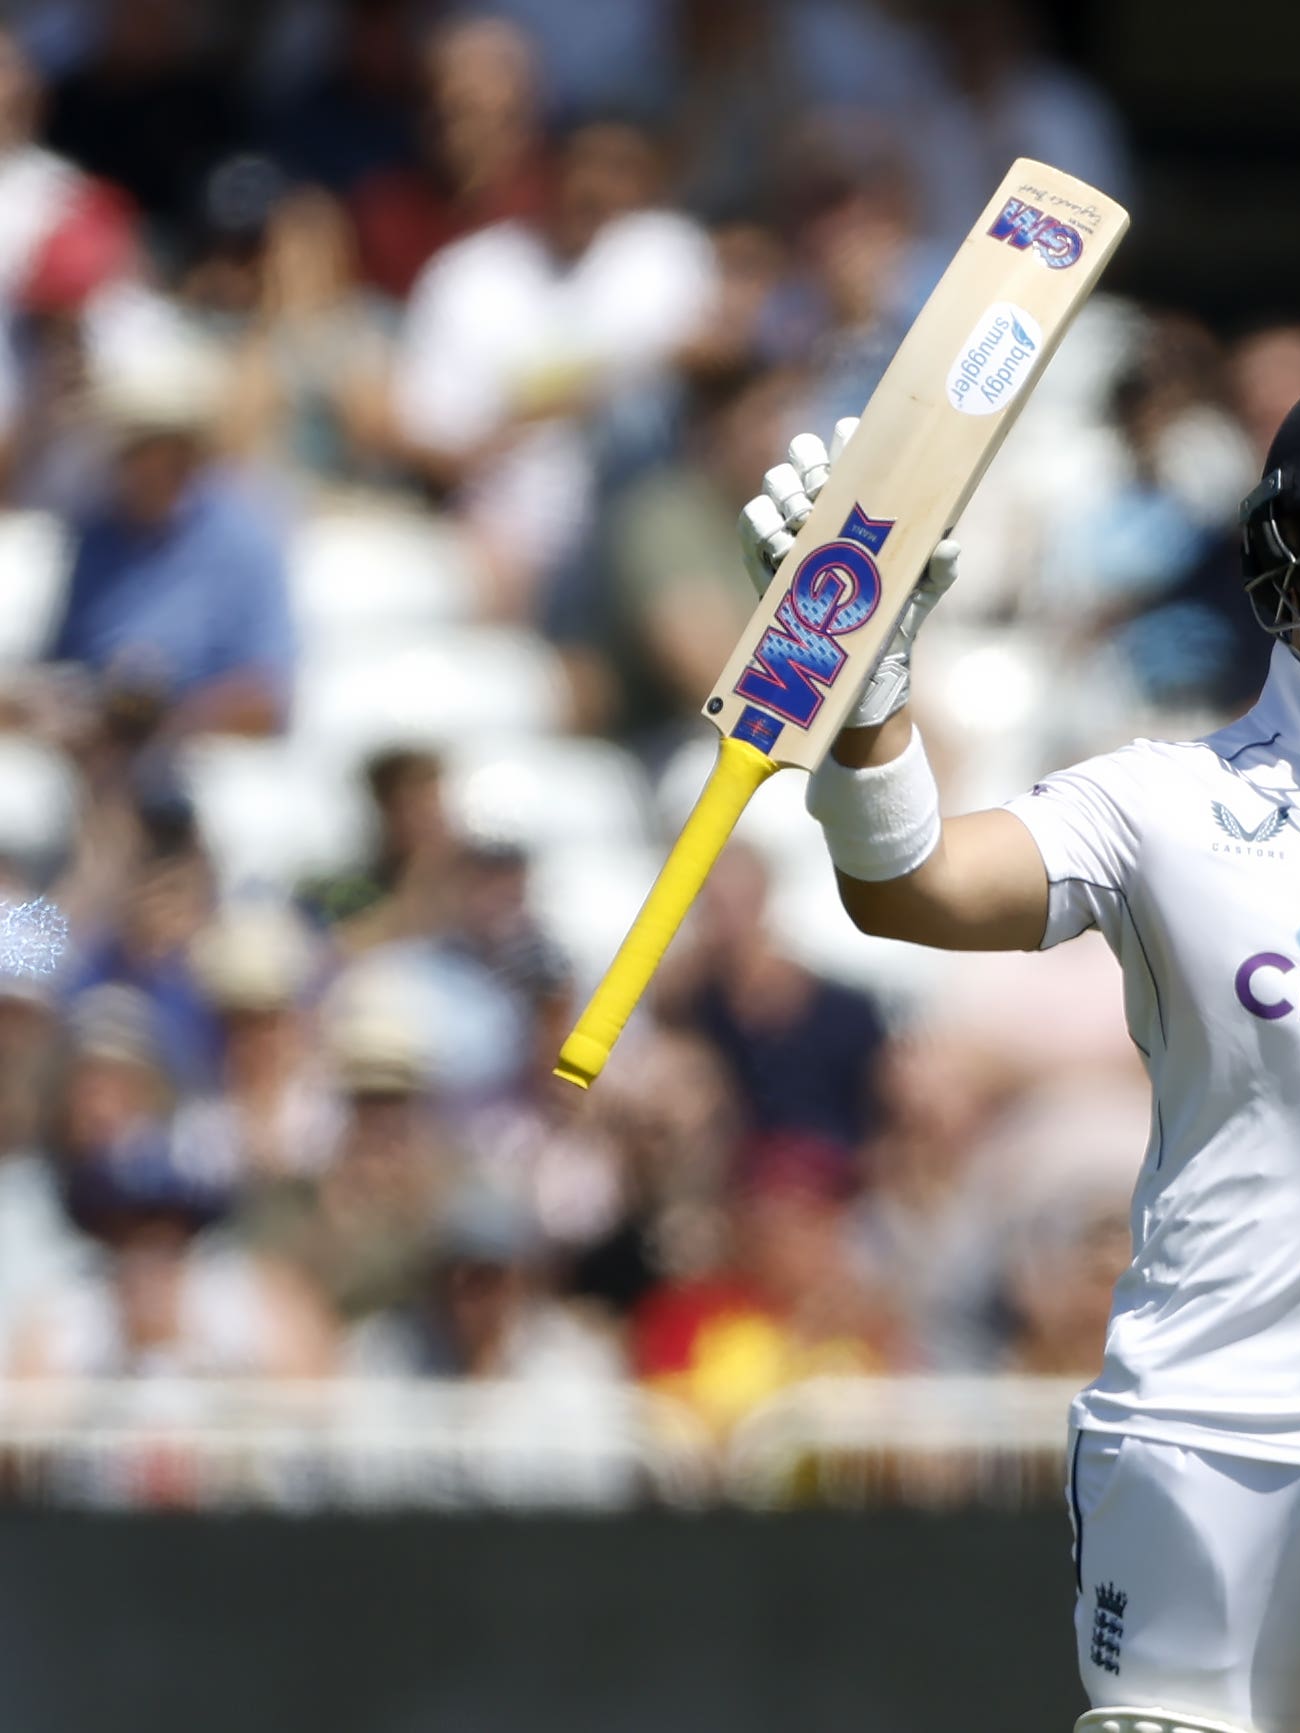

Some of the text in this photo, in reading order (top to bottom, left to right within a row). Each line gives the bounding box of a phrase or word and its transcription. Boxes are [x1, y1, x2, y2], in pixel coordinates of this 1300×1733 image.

[987, 197, 1083, 269] GM
[951, 317, 1009, 402] smuggler
[980, 345, 1031, 404] budgy
[734, 541, 882, 730] GM
[1211, 842, 1285, 860] CASTORE
